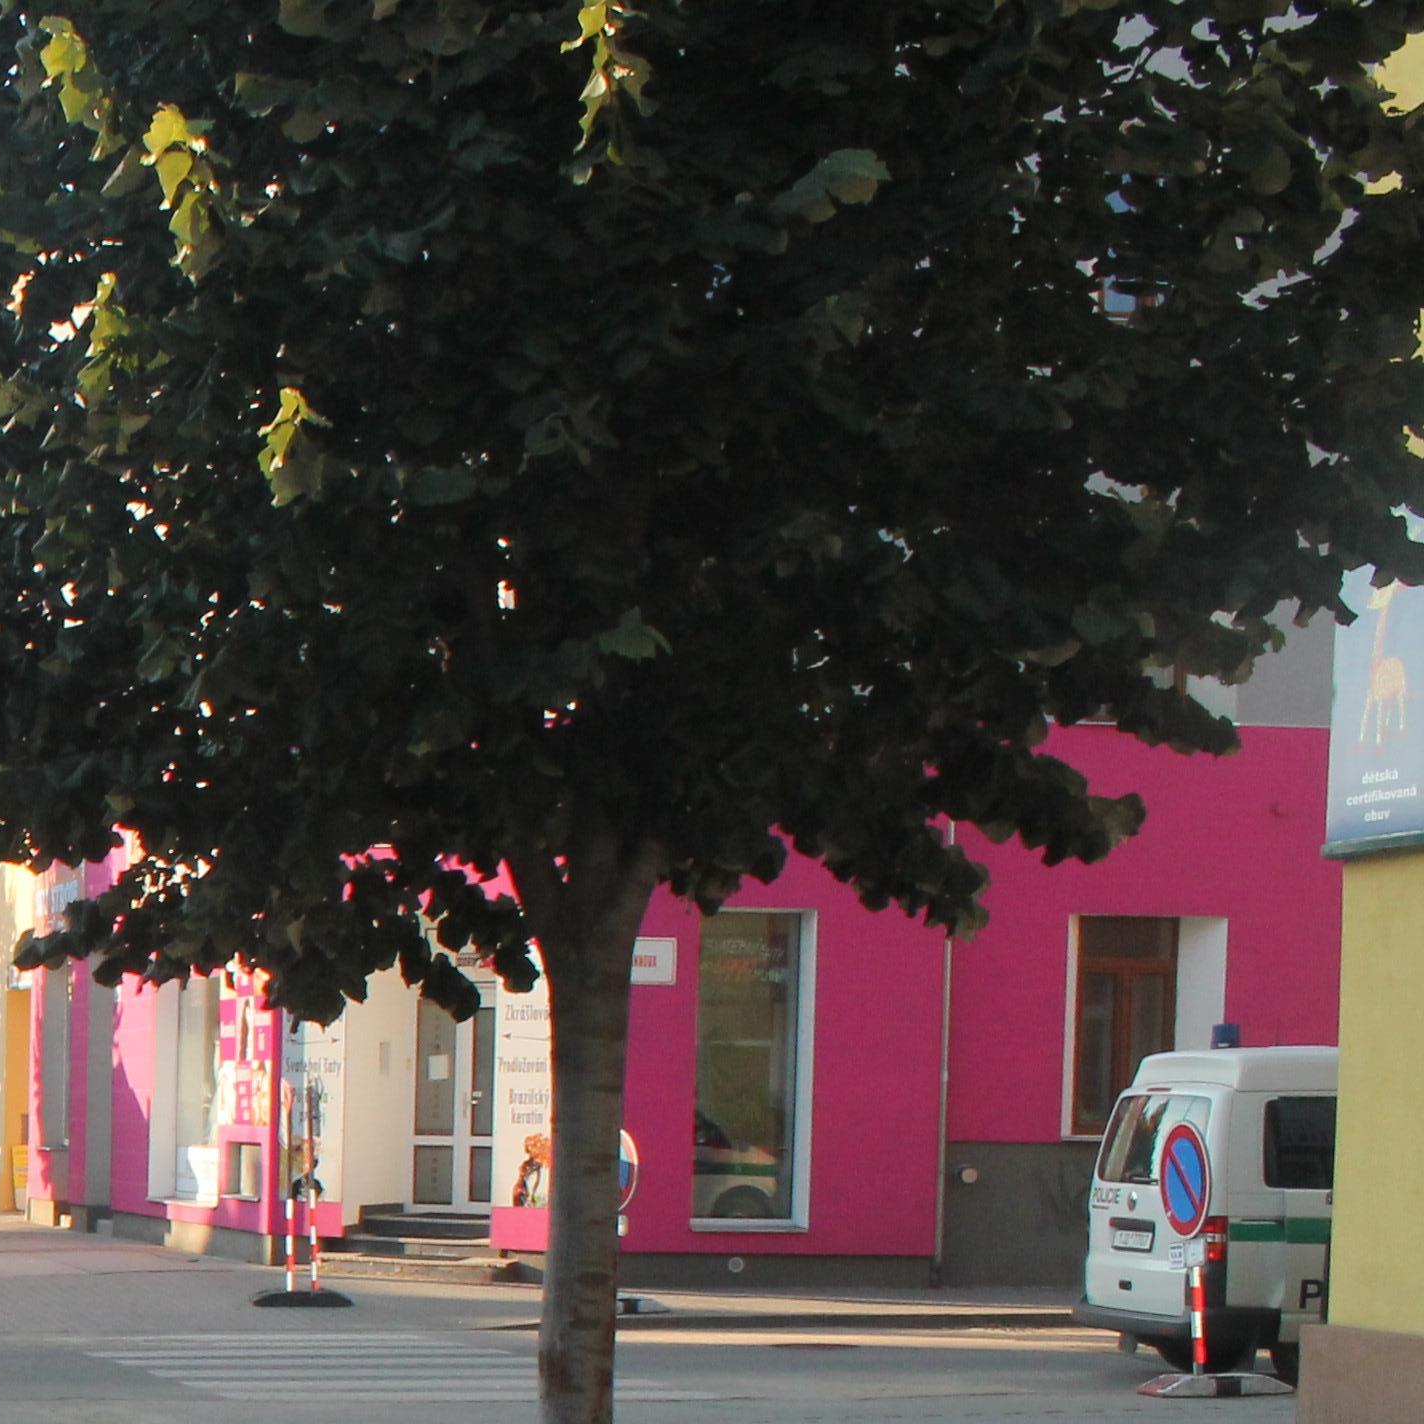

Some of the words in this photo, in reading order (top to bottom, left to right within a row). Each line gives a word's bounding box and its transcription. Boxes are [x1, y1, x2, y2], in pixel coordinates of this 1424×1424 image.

[1362, 768, 1398, 784] dětská
[1346, 784, 1417, 806] certifikovaná
[1364, 808, 1391, 821] obuv
[505, 1004, 550, 1021] Zkrášlová
